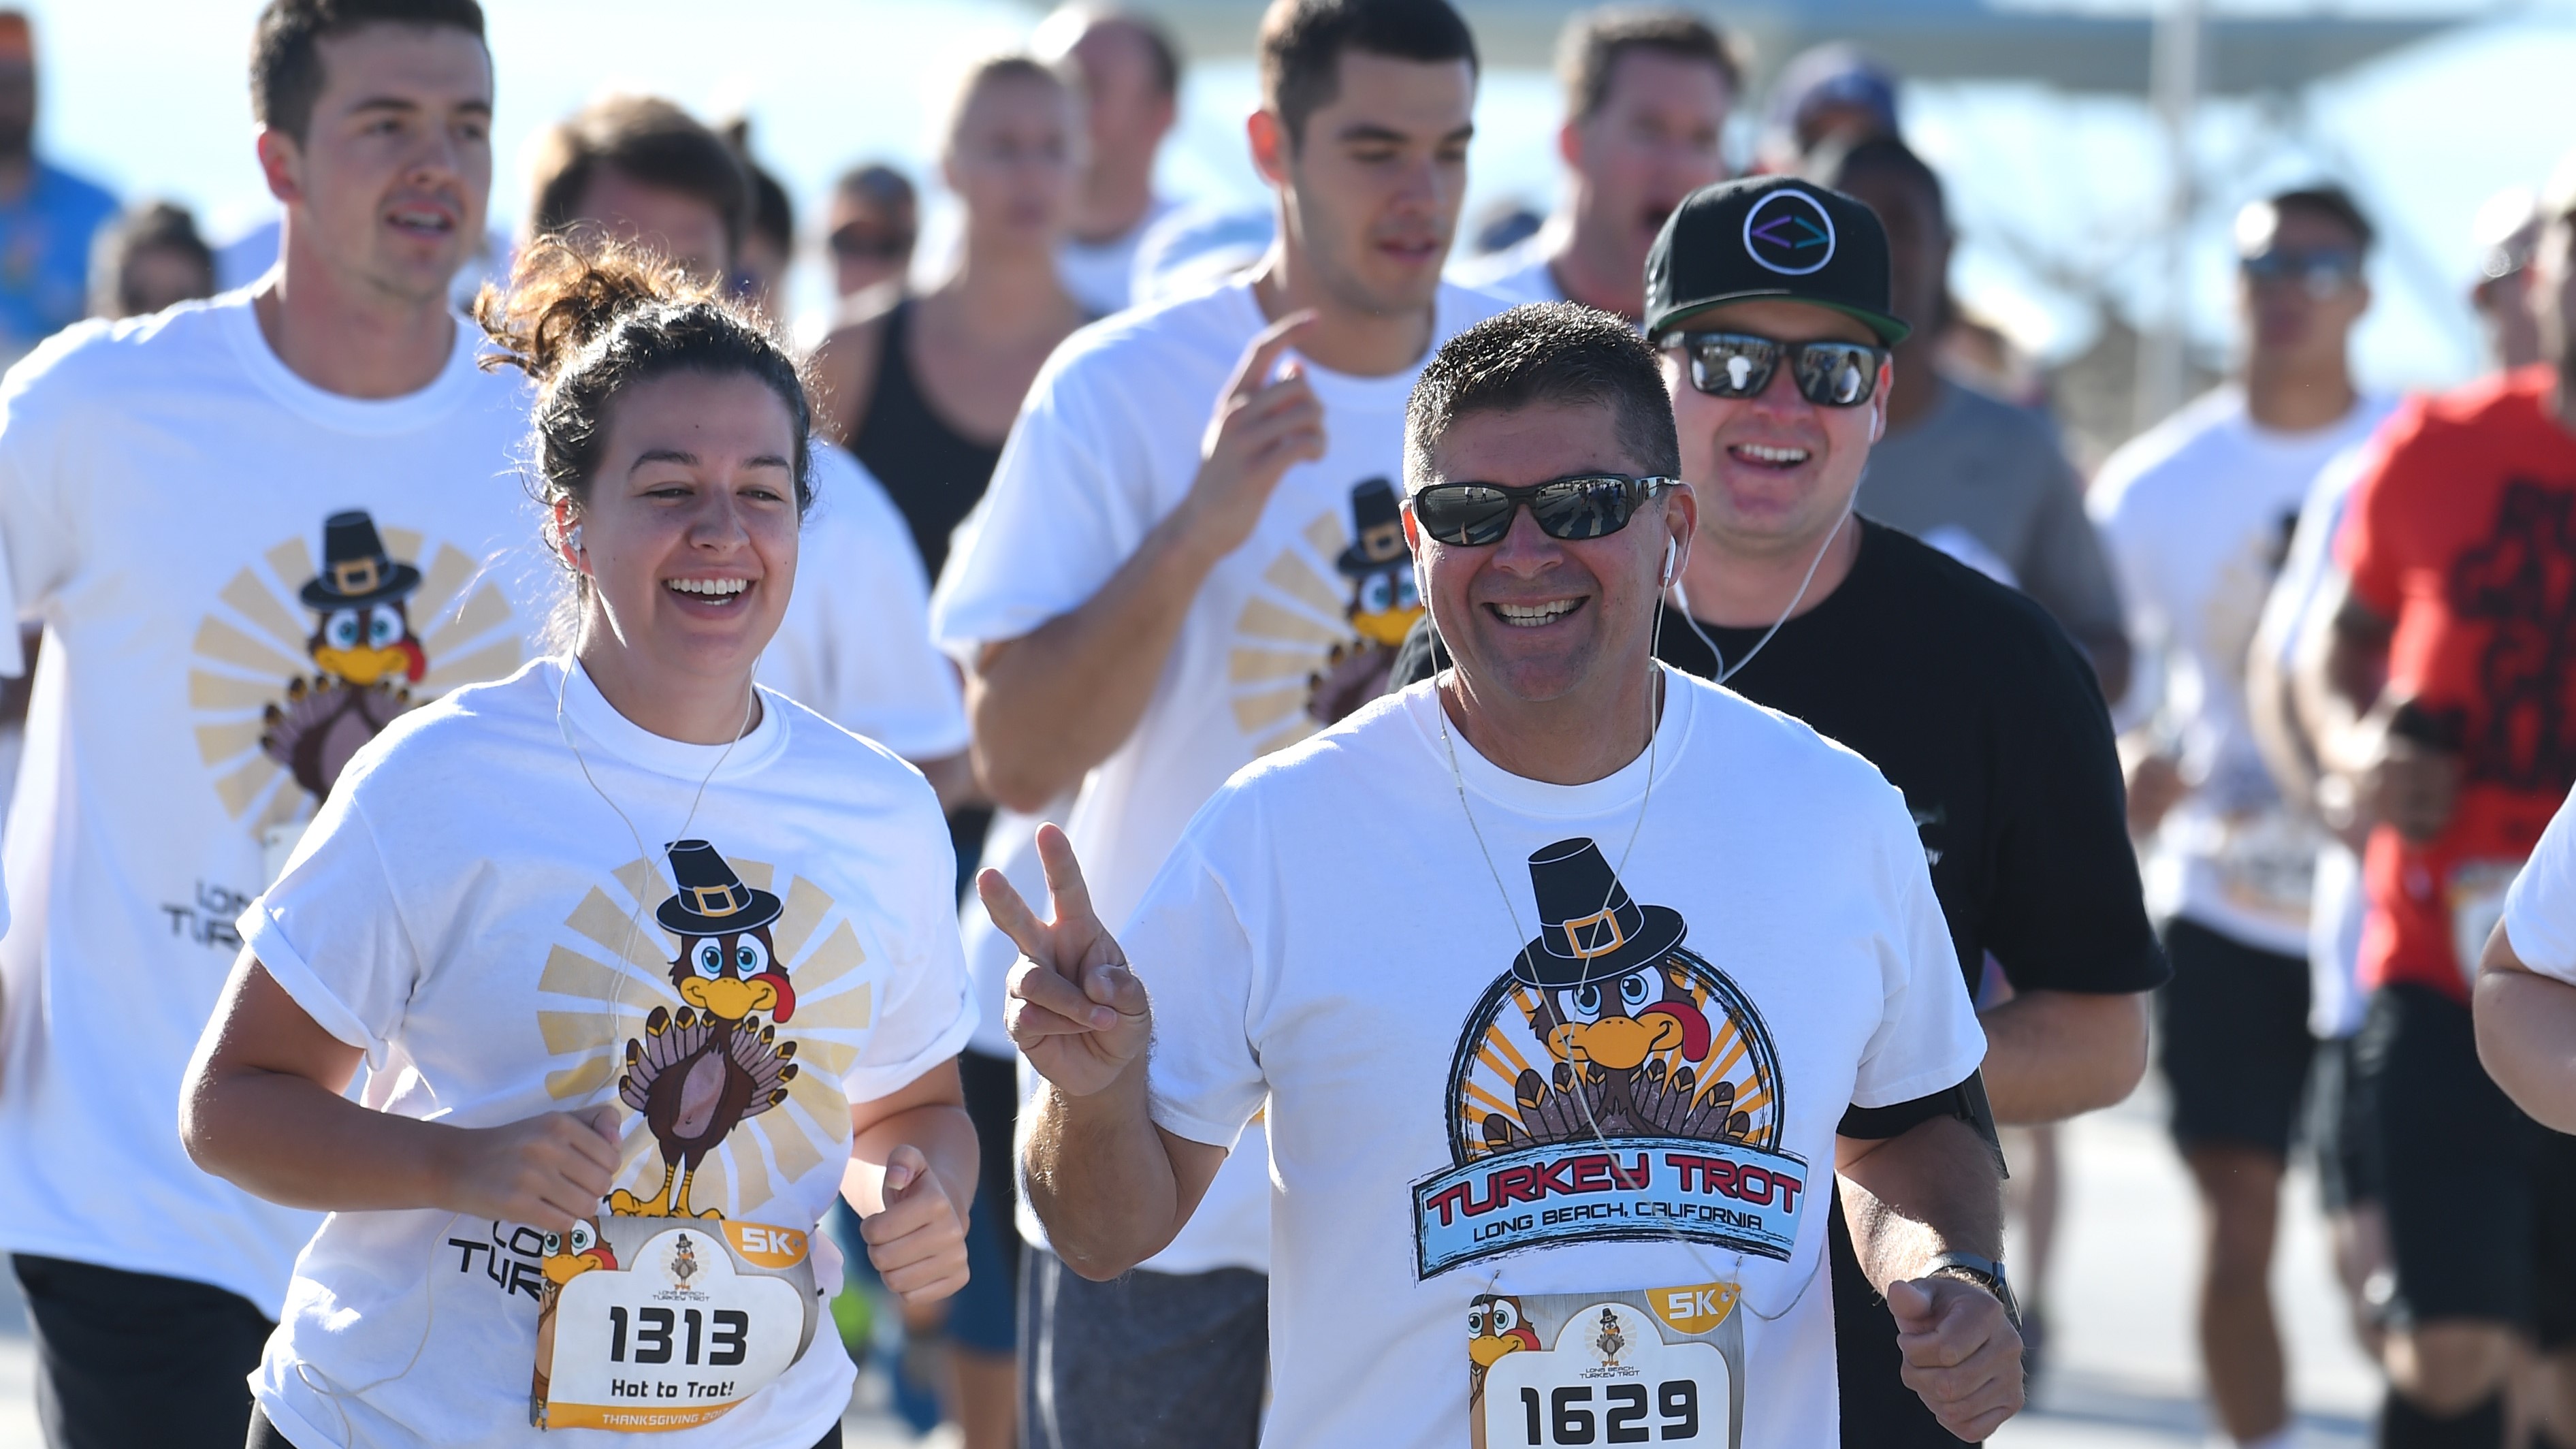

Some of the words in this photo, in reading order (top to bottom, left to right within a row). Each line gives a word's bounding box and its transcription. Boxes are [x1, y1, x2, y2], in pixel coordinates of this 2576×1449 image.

[1426, 1153, 1650, 1227] TURKEY
[1665, 1153, 1802, 1214] TROT
[742, 1227, 795, 1256] 5K
[1473, 1215, 1534, 1243] LONG
[1542, 1203, 1628, 1226] BEACH,
[1635, 1202, 1762, 1230] CALIFORNIA
[448, 1238, 542, 1302] TUR
[1668, 1289, 1719, 1320] 5K
[609, 1306, 749, 1366] 1313
[611, 1378, 649, 1397] Hot
[656, 1381, 678, 1398] to
[687, 1381, 735, 1398] Trot!
[602, 1412, 700, 1426] THANKSGIVING
[1520, 1380, 1698, 1446] 1629
